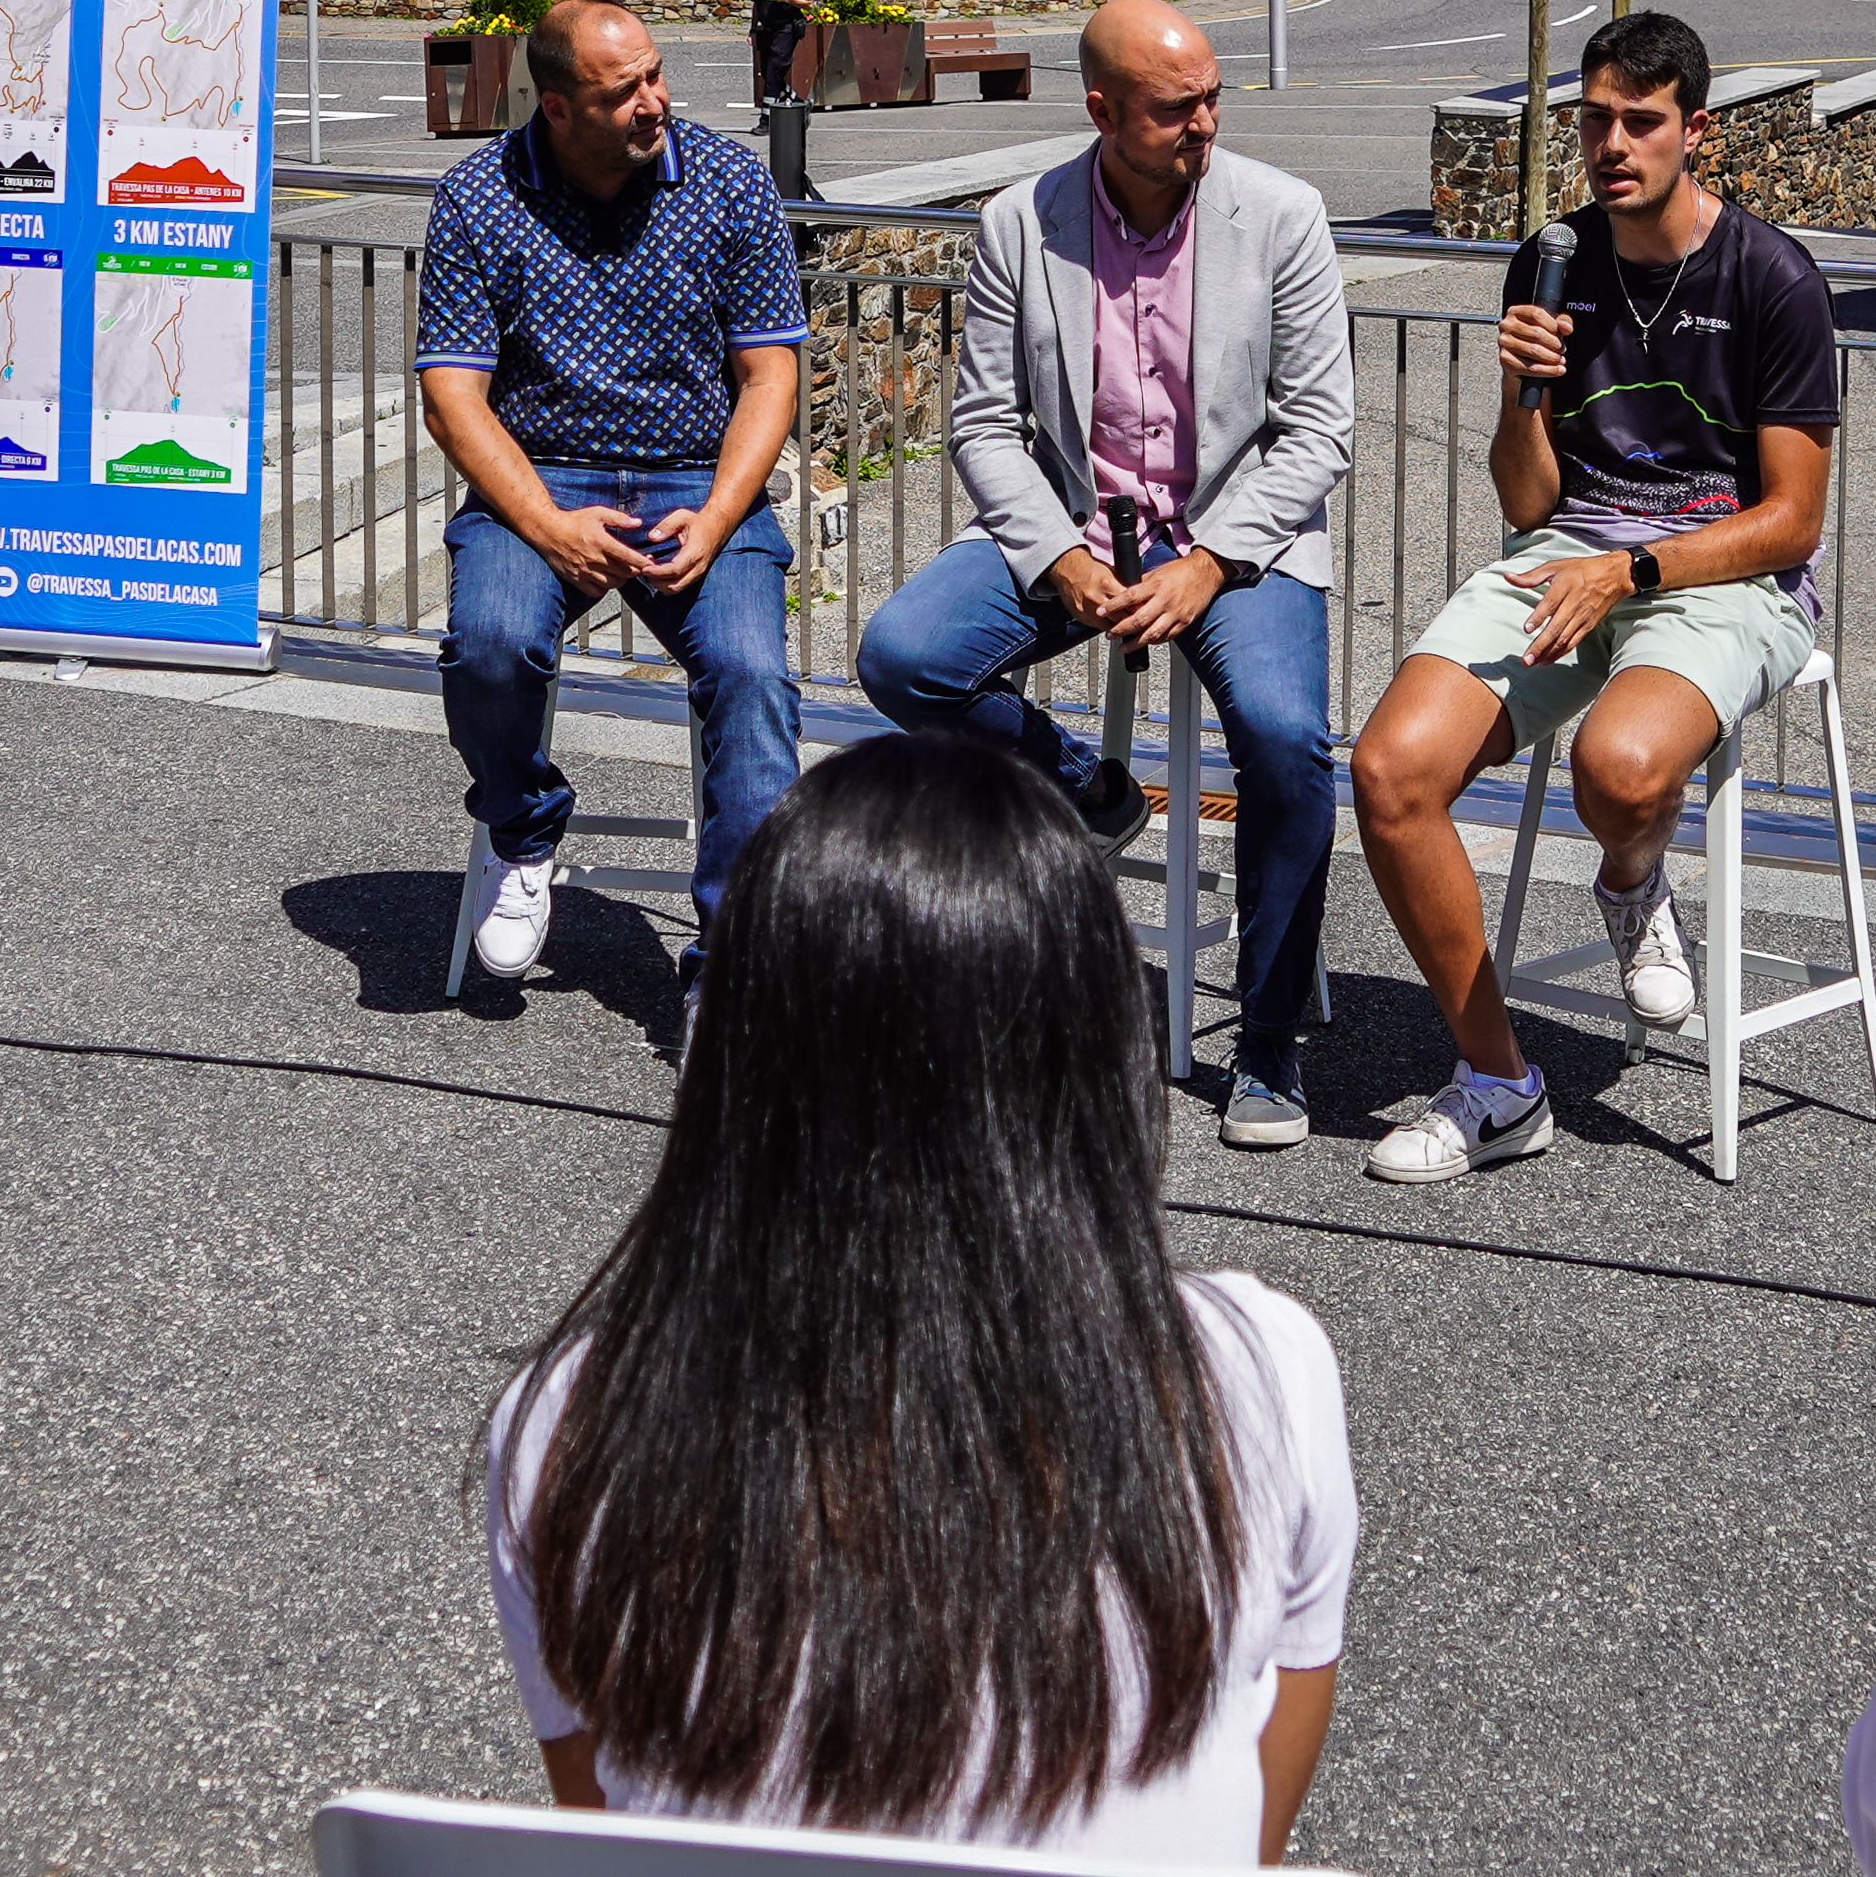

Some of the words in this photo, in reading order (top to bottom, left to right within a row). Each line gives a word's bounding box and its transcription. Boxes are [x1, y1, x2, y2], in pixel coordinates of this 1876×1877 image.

[113, 219, 126, 244] 3
[130, 221, 159, 246] KM
[163, 222, 234, 249] ESTANY
[27, 573, 219, 607] @TRAVESSA_PASDELACASA
